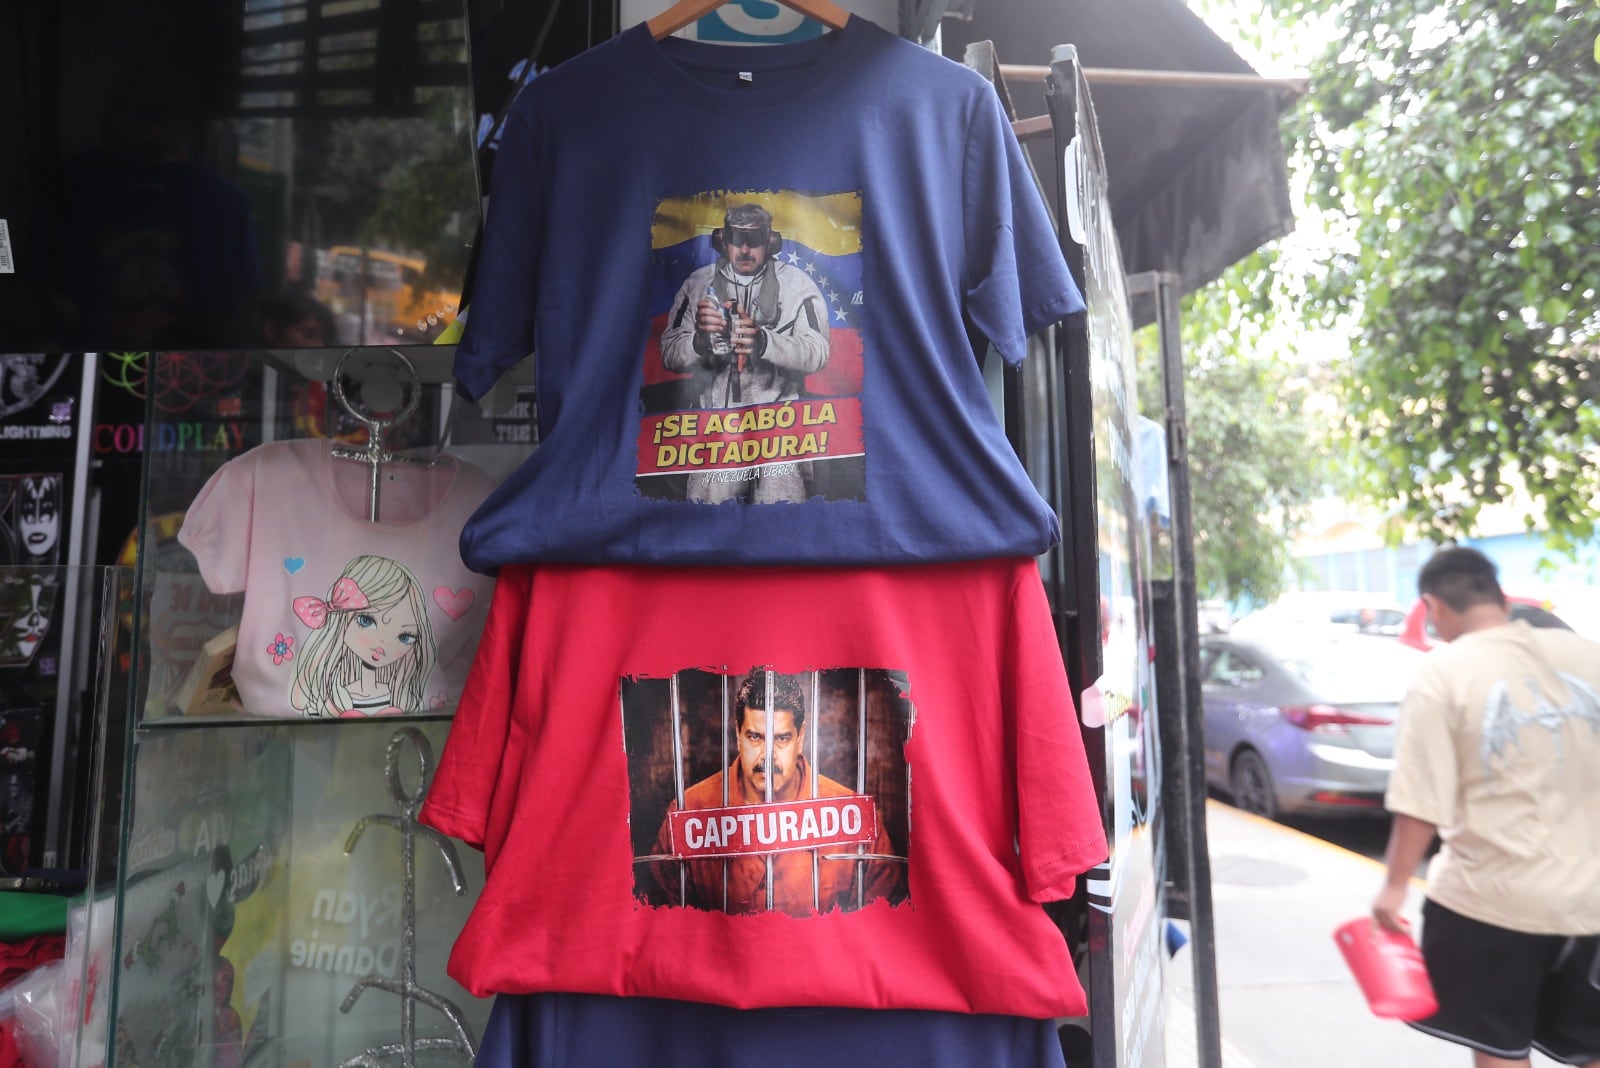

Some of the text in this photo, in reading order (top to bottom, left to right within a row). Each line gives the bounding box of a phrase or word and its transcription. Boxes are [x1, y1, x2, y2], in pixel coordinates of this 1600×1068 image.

[653, 401, 837, 444] ¡SE ACABÓ LA
[656, 431, 829, 468] DICTADURA!
[684, 804, 863, 849] CAPTURADO
